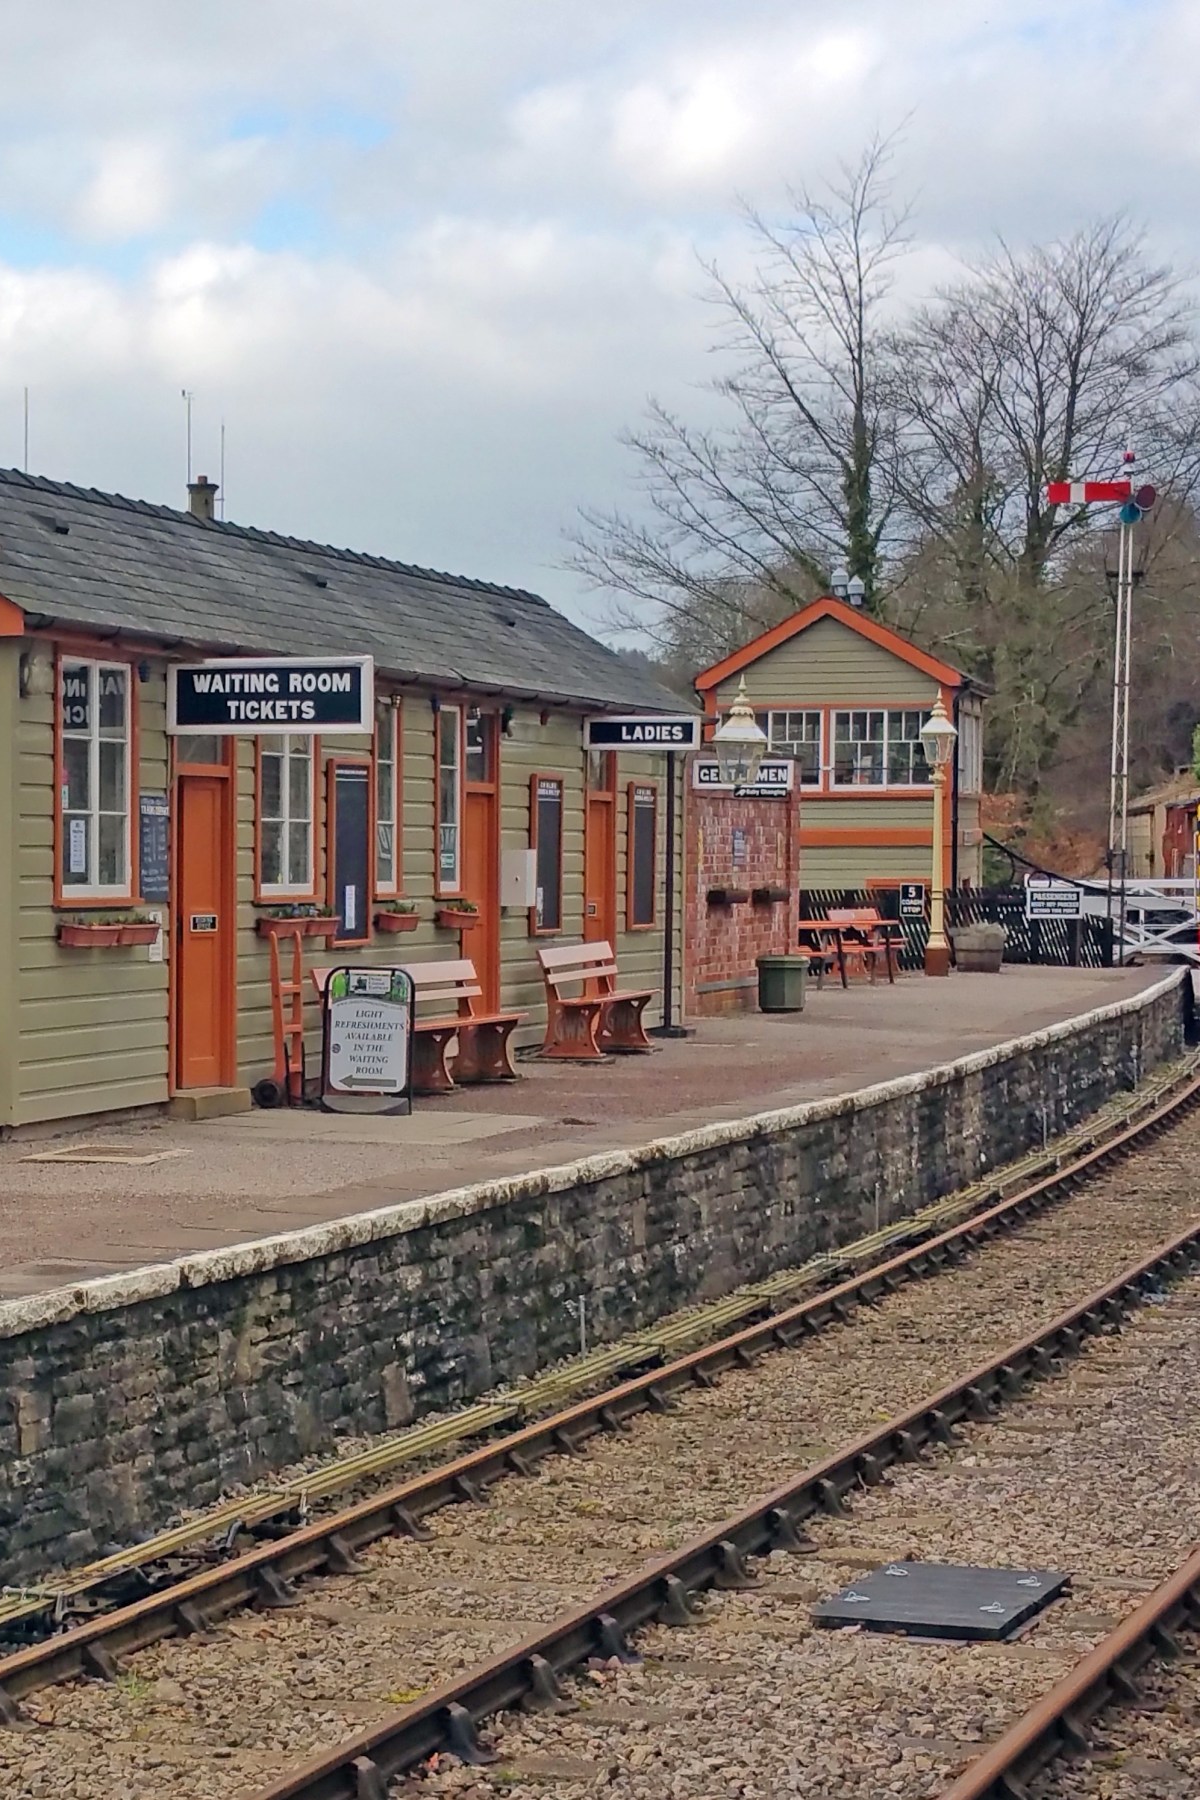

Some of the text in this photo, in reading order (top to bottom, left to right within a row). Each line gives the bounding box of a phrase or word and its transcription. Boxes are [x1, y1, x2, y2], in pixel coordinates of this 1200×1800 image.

[193, 673, 350, 693] WAITING ROOM
[227, 701, 315, 720] TICKETS
[621, 725, 683, 740] LADIES
[908, 886, 916, 897] 5
[355, 1010, 384, 1018] LIGHT
[335, 1020, 404, 1030] REFRESHMENTS
[345, 1032, 393, 1041] AVAILABLE
[354, 1044, 384, 1052] IN THE
[349, 1055, 388, 1063] WAITING
[355, 1066, 383, 1075] ROOM
